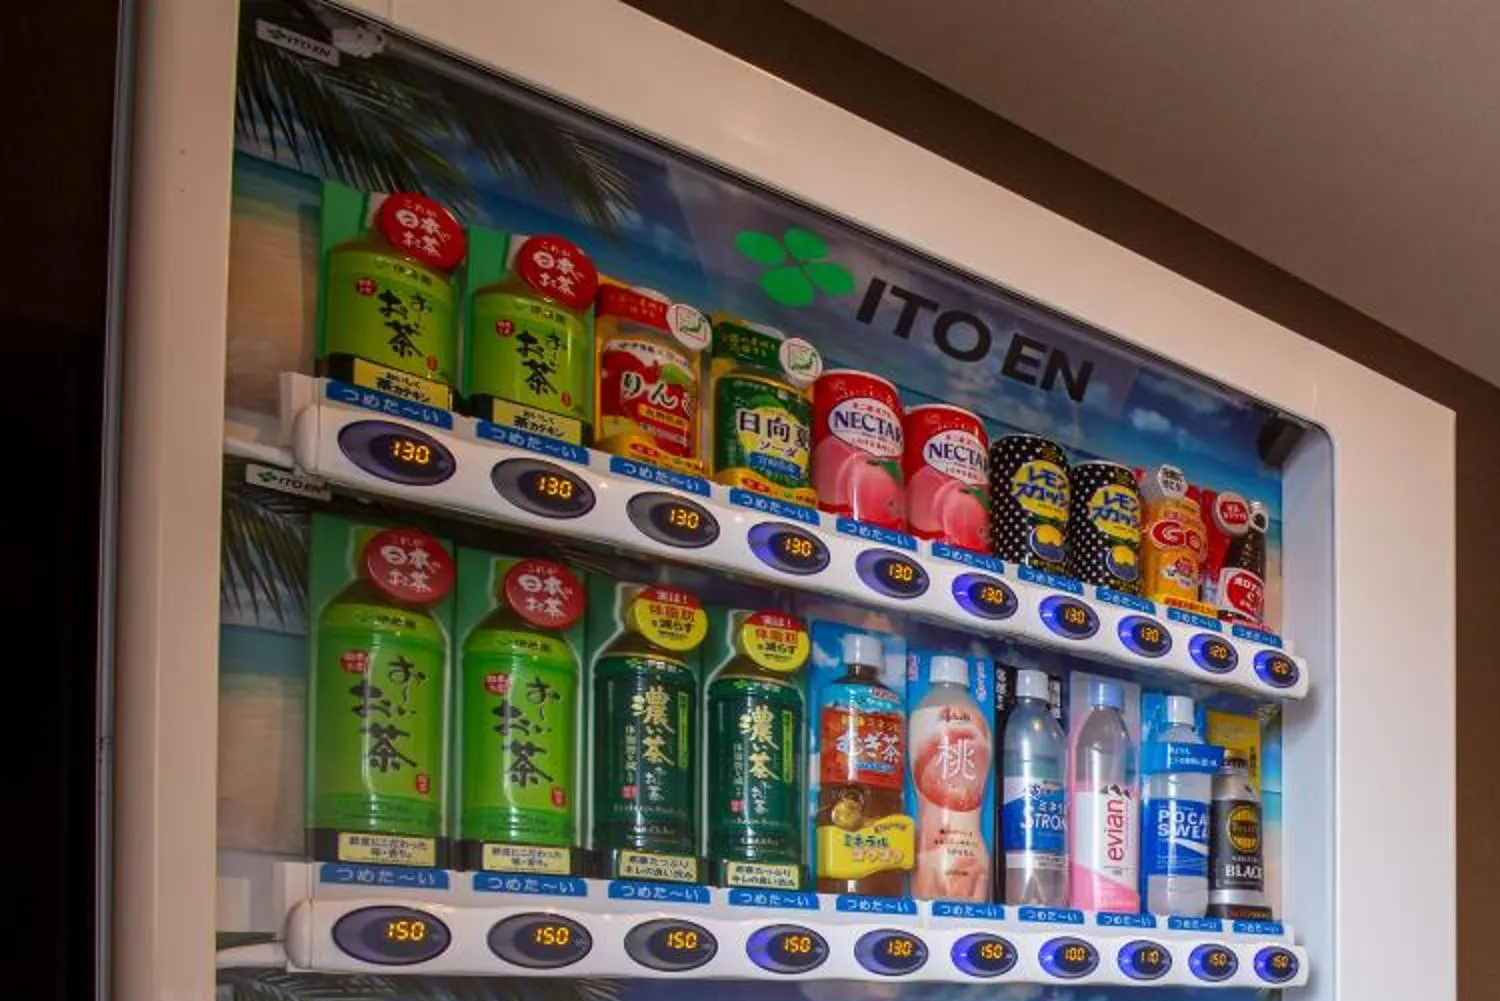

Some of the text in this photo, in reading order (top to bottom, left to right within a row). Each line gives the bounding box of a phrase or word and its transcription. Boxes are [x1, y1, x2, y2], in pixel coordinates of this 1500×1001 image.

[376, 289, 424, 358] お茶
[856, 278, 1094, 403] ITO EN
[514, 330, 559, 395] お茶
[390, 440, 430, 465] 130
[535, 475, 574, 499] 130
[669, 508, 701, 530] 130
[783, 536, 811, 557] 130
[887, 562, 913, 582] 130
[982, 587, 1004, 606] 130
[1064, 607, 1085, 625] 130
[349, 680, 418, 773] お茶
[491, 700, 555, 788] お茶
[835, 729, 901, 763] むぎ茶
[936, 736, 976, 780] 桃
[1106, 801, 1124, 862] evian
[387, 921, 425, 941] 150
[534, 927, 570, 945] 150
[668, 930, 698, 949] 150
[783, 935, 811, 953] 150
[887, 939, 913, 957] 130
[981, 943, 1003, 959] 150
[1065, 947, 1085, 962] 100
